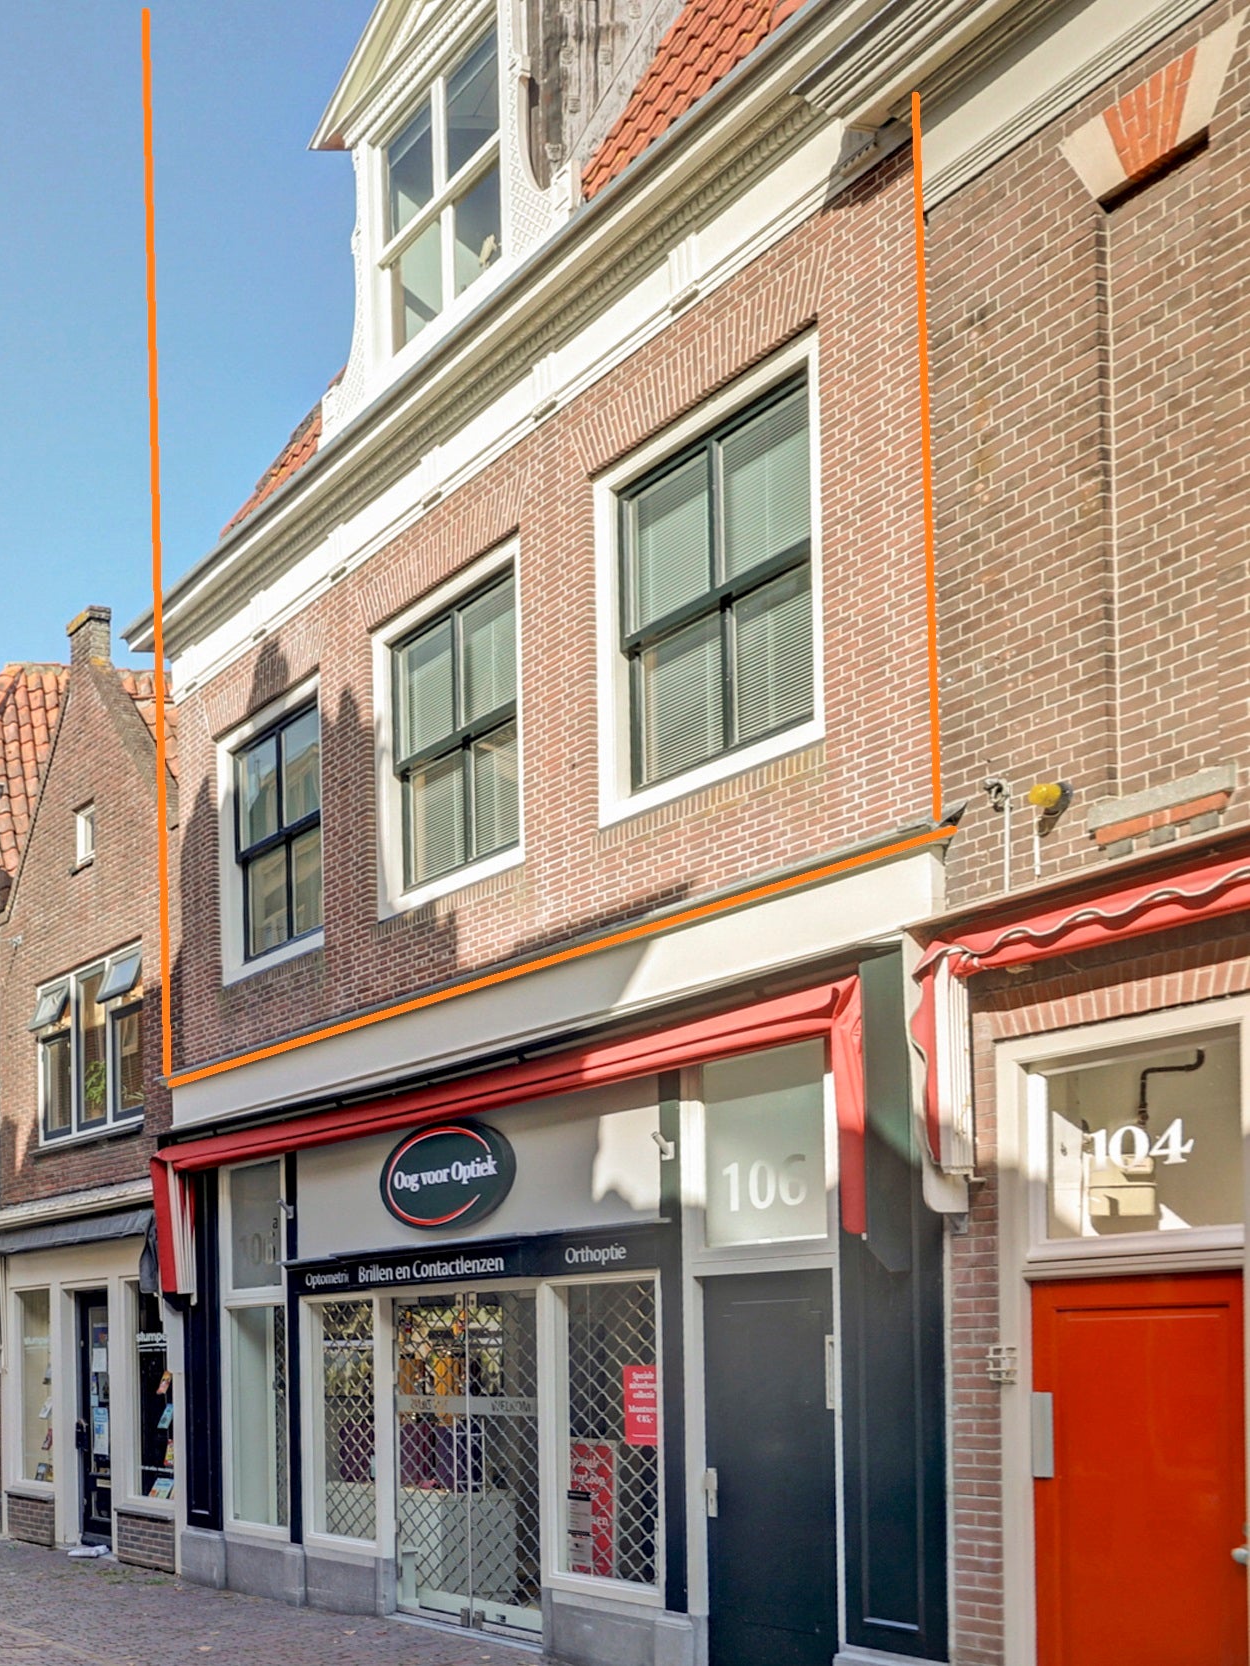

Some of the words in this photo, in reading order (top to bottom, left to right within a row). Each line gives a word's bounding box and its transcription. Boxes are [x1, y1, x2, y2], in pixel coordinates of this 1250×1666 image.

[1092, 1118, 1195, 1170] 104
[393, 1171, 420, 1192] Oog
[421, 1168, 451, 1185] voor
[451, 1154, 498, 1185] Optiek
[722, 1153, 808, 1212] 106
[564, 1242, 628, 1266] Orthoptie
[305, 1268, 350, 1290] Optometri
[358, 1264, 393, 1284] Brillen
[395, 1265, 411, 1280] en
[412, 1255, 505, 1279] Contactlenzen
[136, 1331, 167, 1344] stumpe
